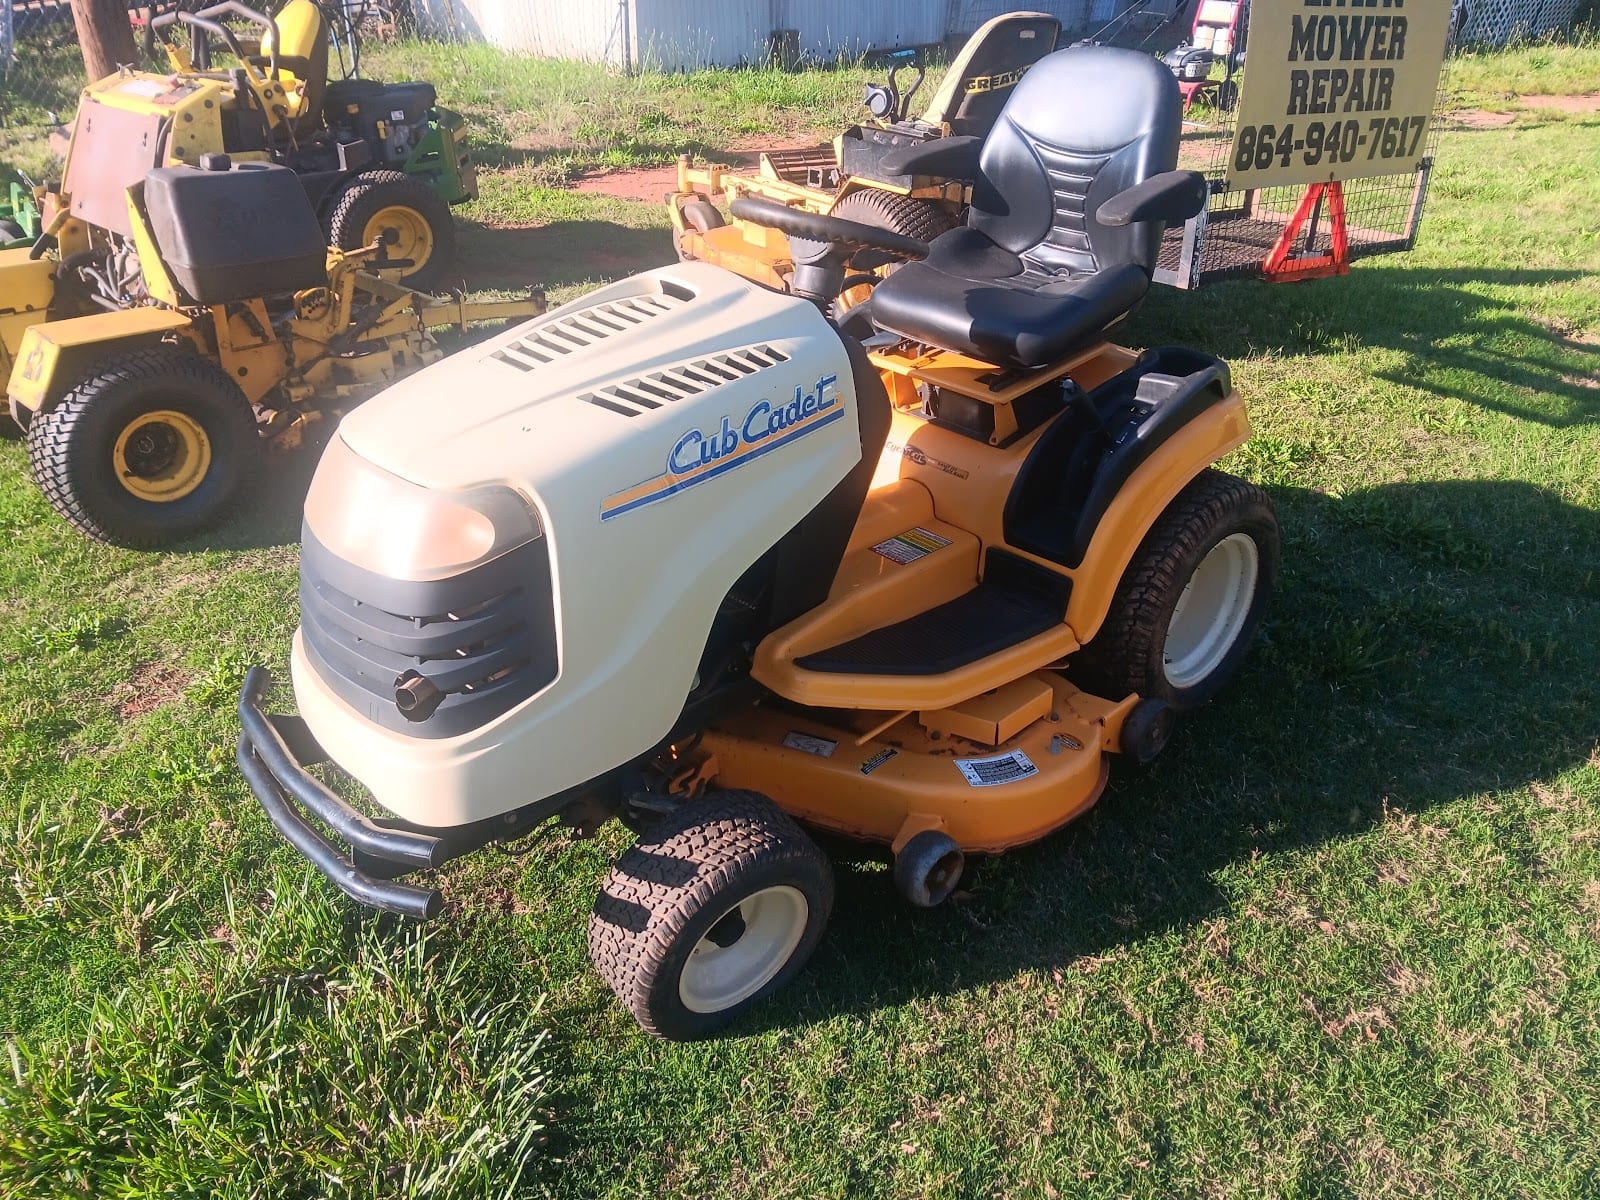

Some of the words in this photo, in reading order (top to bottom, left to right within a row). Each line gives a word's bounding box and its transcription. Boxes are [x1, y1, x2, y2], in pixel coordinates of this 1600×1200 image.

[1288, 14, 1408, 61] MOWER
[965, 72, 1016, 90] GREAT
[1287, 68, 1395, 115] REPAIR
[1234, 116, 1426, 171] 864-940-7617
[669, 417, 738, 475] Cub
[742, 375, 837, 443] Cadet
